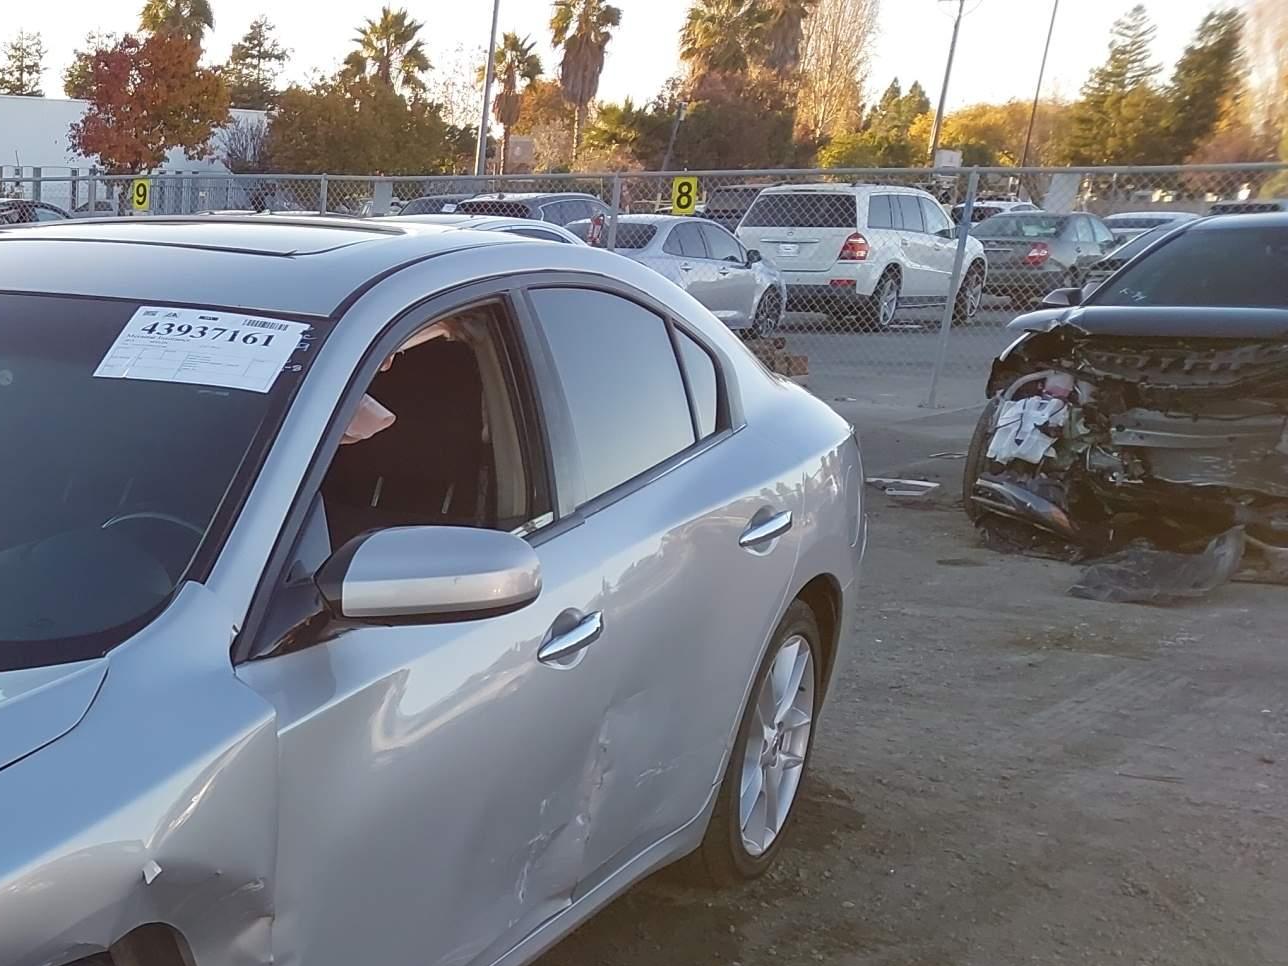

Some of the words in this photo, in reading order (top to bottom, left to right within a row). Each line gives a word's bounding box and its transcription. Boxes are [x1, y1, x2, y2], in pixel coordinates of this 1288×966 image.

[135, 182, 148, 206] 9
[676, 181, 693, 210] 8
[141, 321, 276, 347] 43937161
